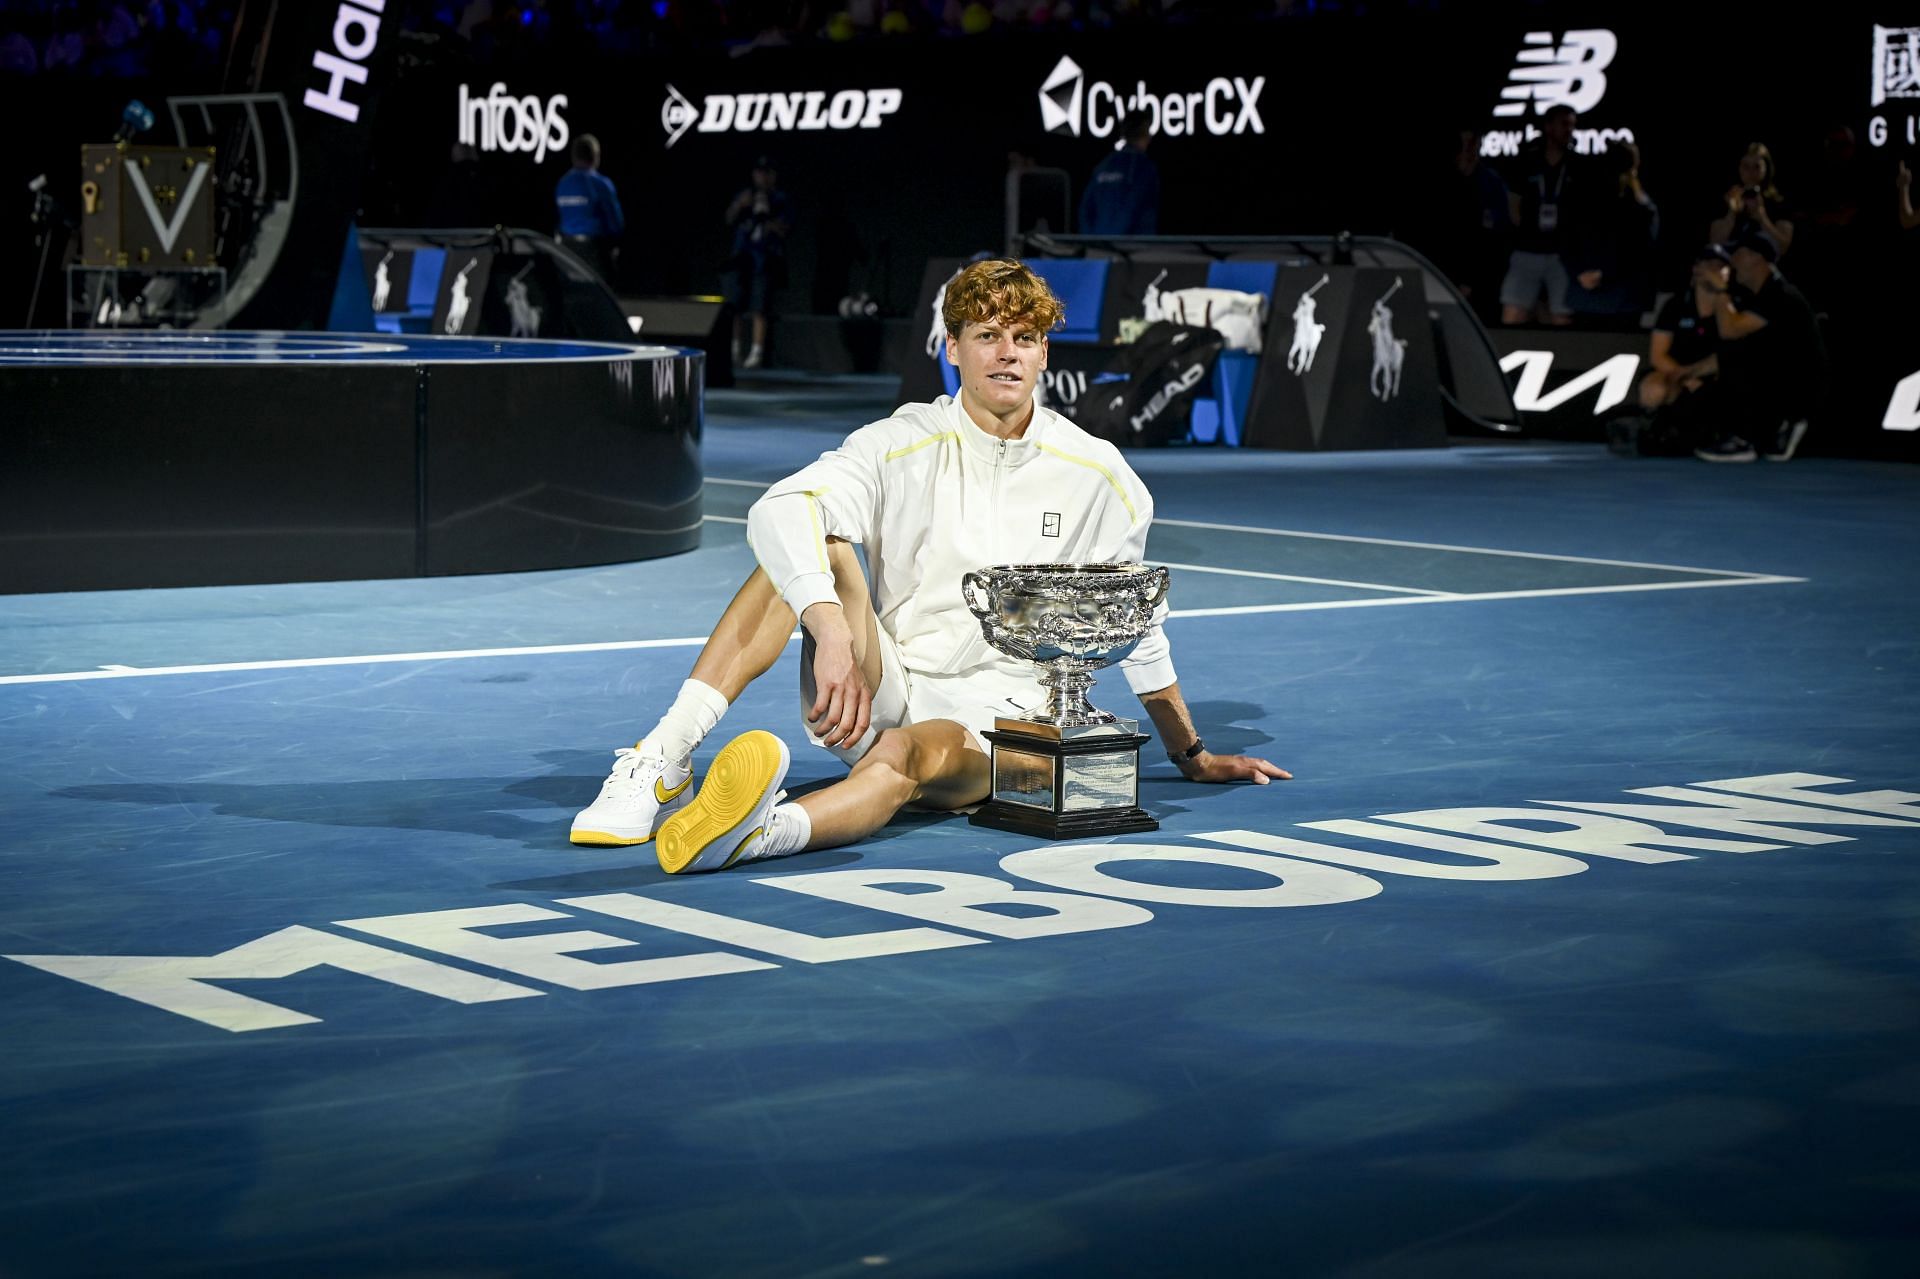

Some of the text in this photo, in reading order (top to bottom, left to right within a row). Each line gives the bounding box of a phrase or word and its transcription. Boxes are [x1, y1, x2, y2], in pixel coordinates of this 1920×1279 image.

[458, 81, 569, 163] Infosys
[697, 88, 902, 133] DUNLOP
[1087, 75, 1266, 150] CyberCX
[1130, 363, 1205, 432] HEAD
[5, 772, 1920, 1032] MELBOURNE
